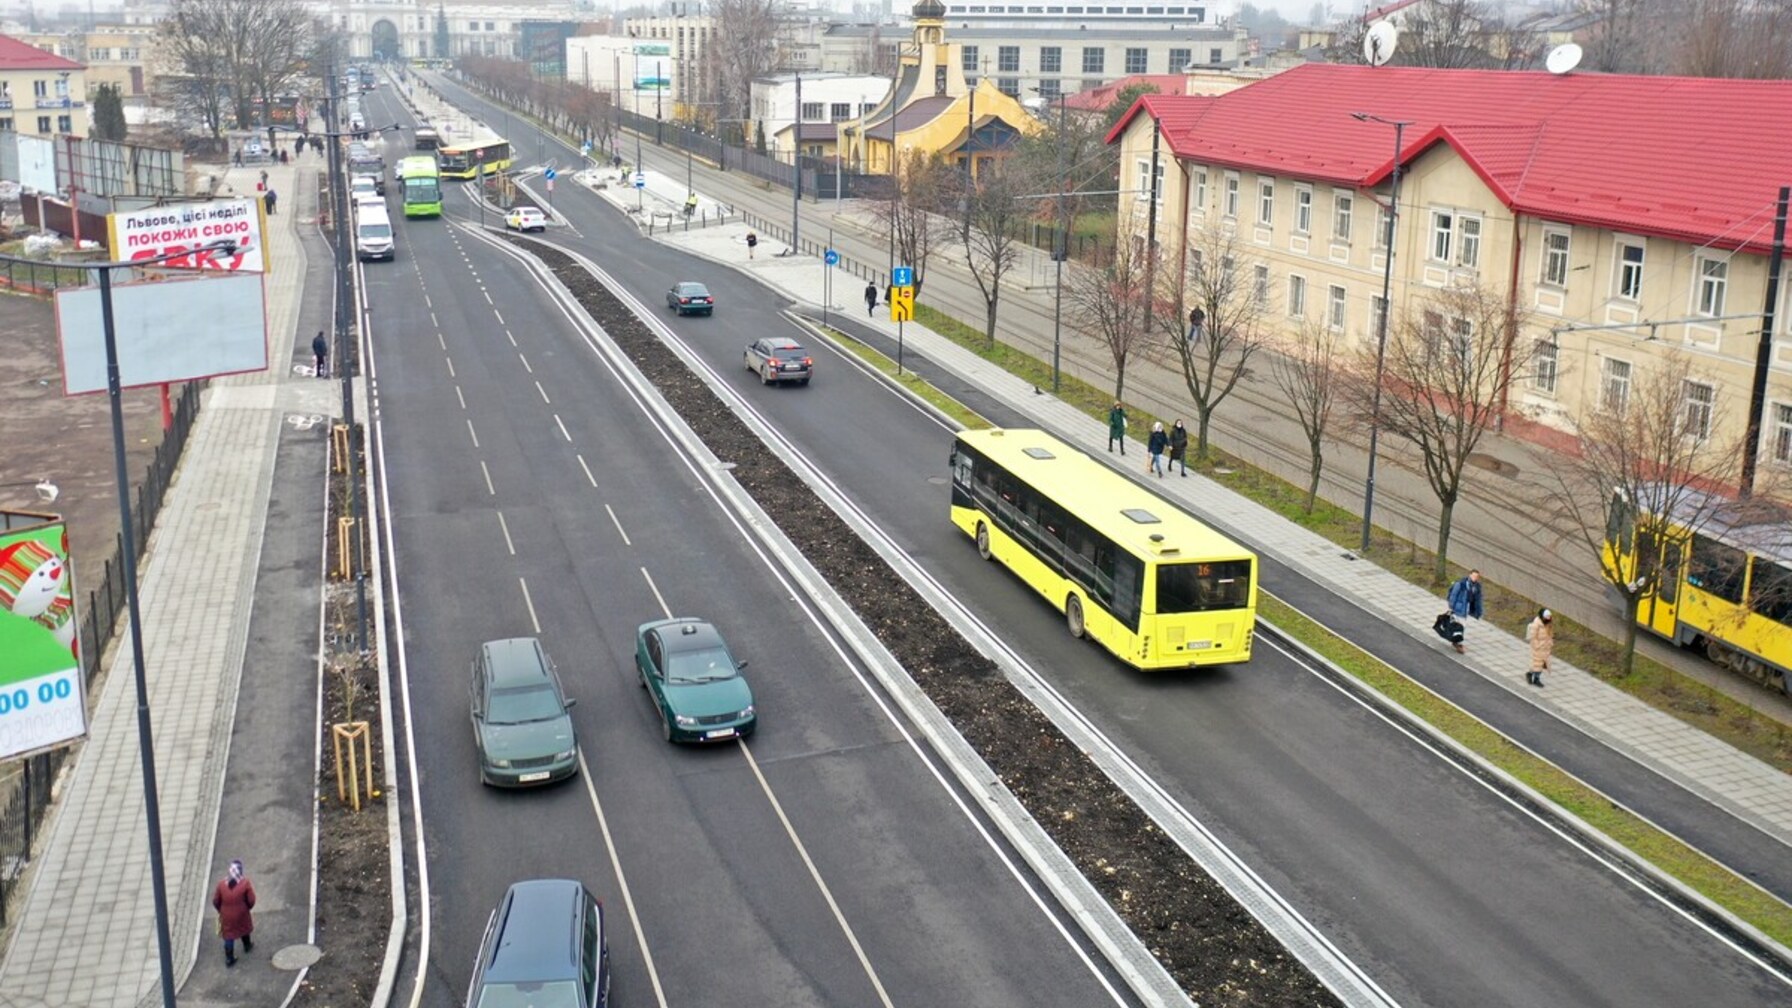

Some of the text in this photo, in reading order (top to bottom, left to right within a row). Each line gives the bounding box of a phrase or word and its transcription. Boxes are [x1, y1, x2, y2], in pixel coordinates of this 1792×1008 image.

[127, 215, 180, 229] Львове,
[209, 203, 248, 219] неділі
[128, 220, 249, 246] покажи свою
[1198, 564, 1210, 576] 16
[38, 678, 71, 703] 00
